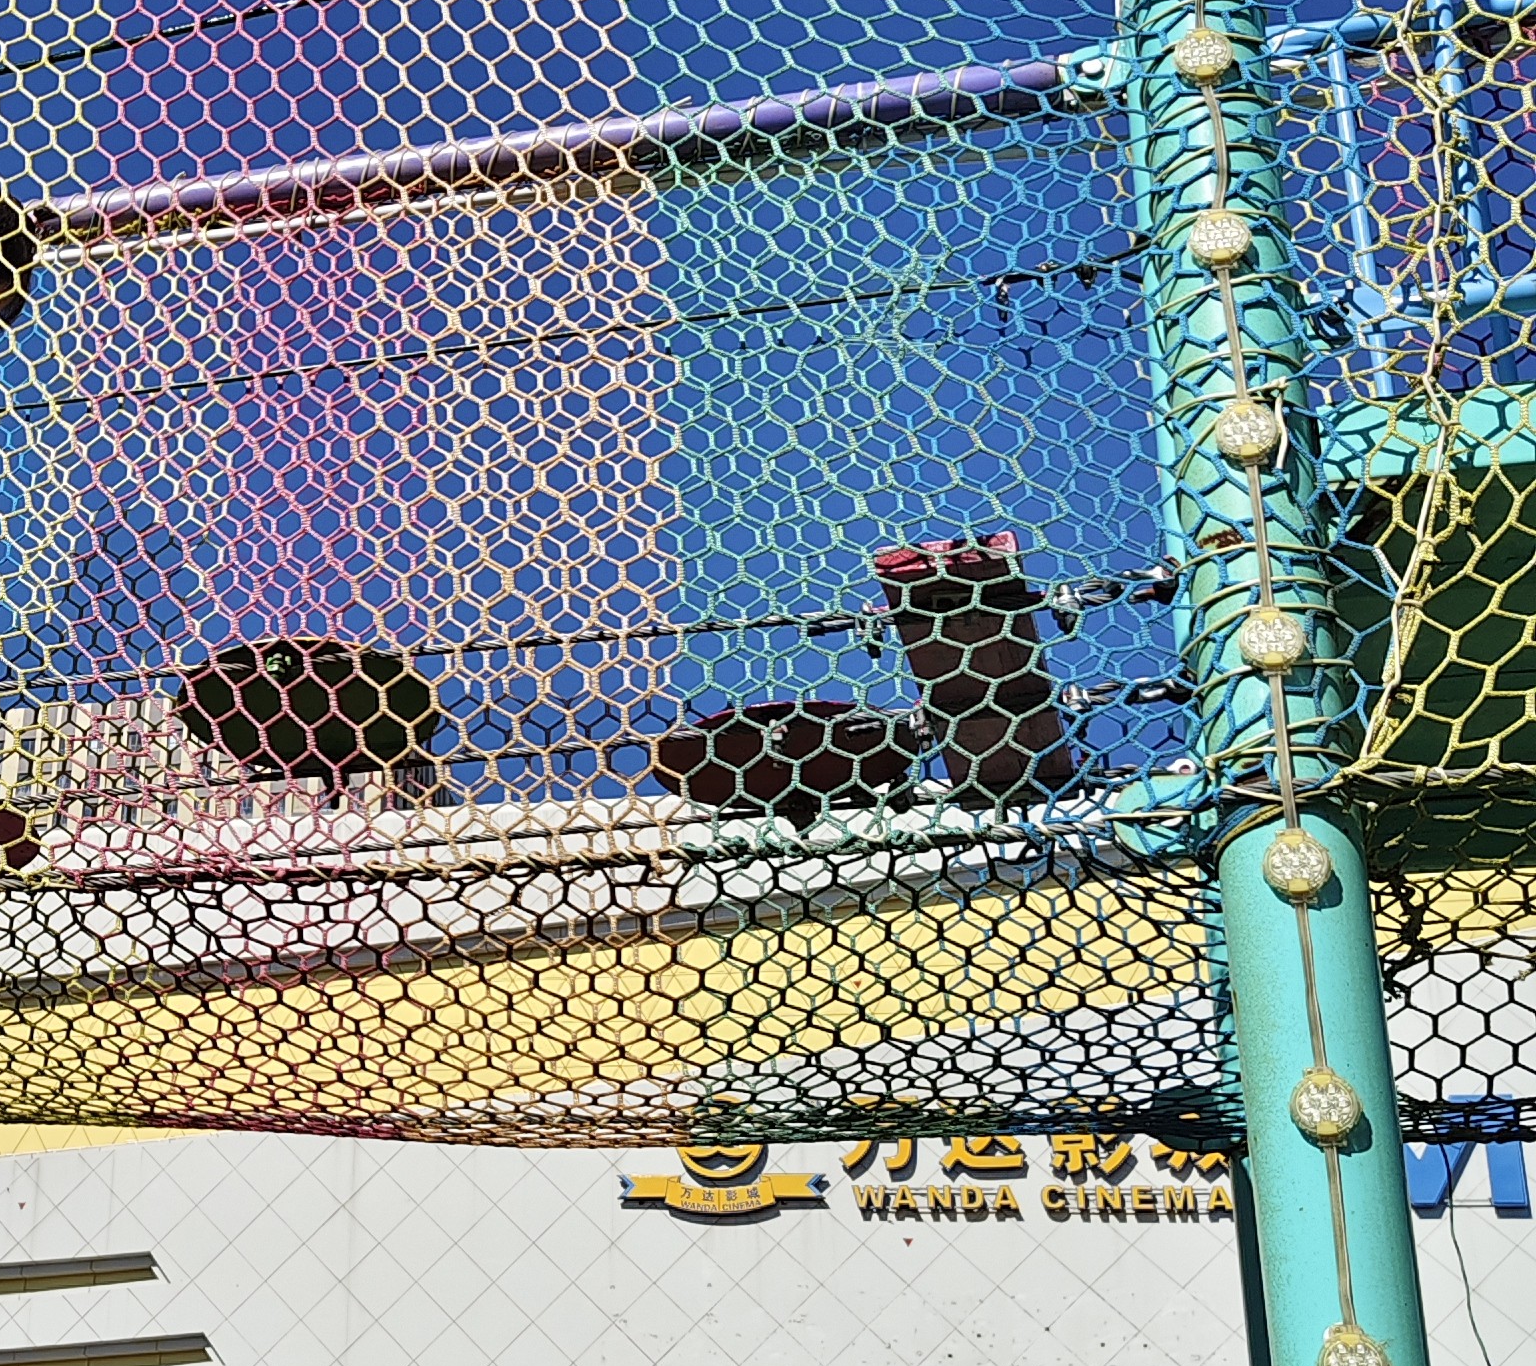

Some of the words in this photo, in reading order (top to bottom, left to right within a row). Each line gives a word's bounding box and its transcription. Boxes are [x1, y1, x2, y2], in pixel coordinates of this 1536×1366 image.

[680, 1186, 761, 1202] 万达影城
[852, 1184, 1020, 1211] WANDA
[1041, 1185, 1234, 1212] CINEMA
[680, 1200, 718, 1212] WANDA
[722, 1199, 762, 1211] CINEMA
